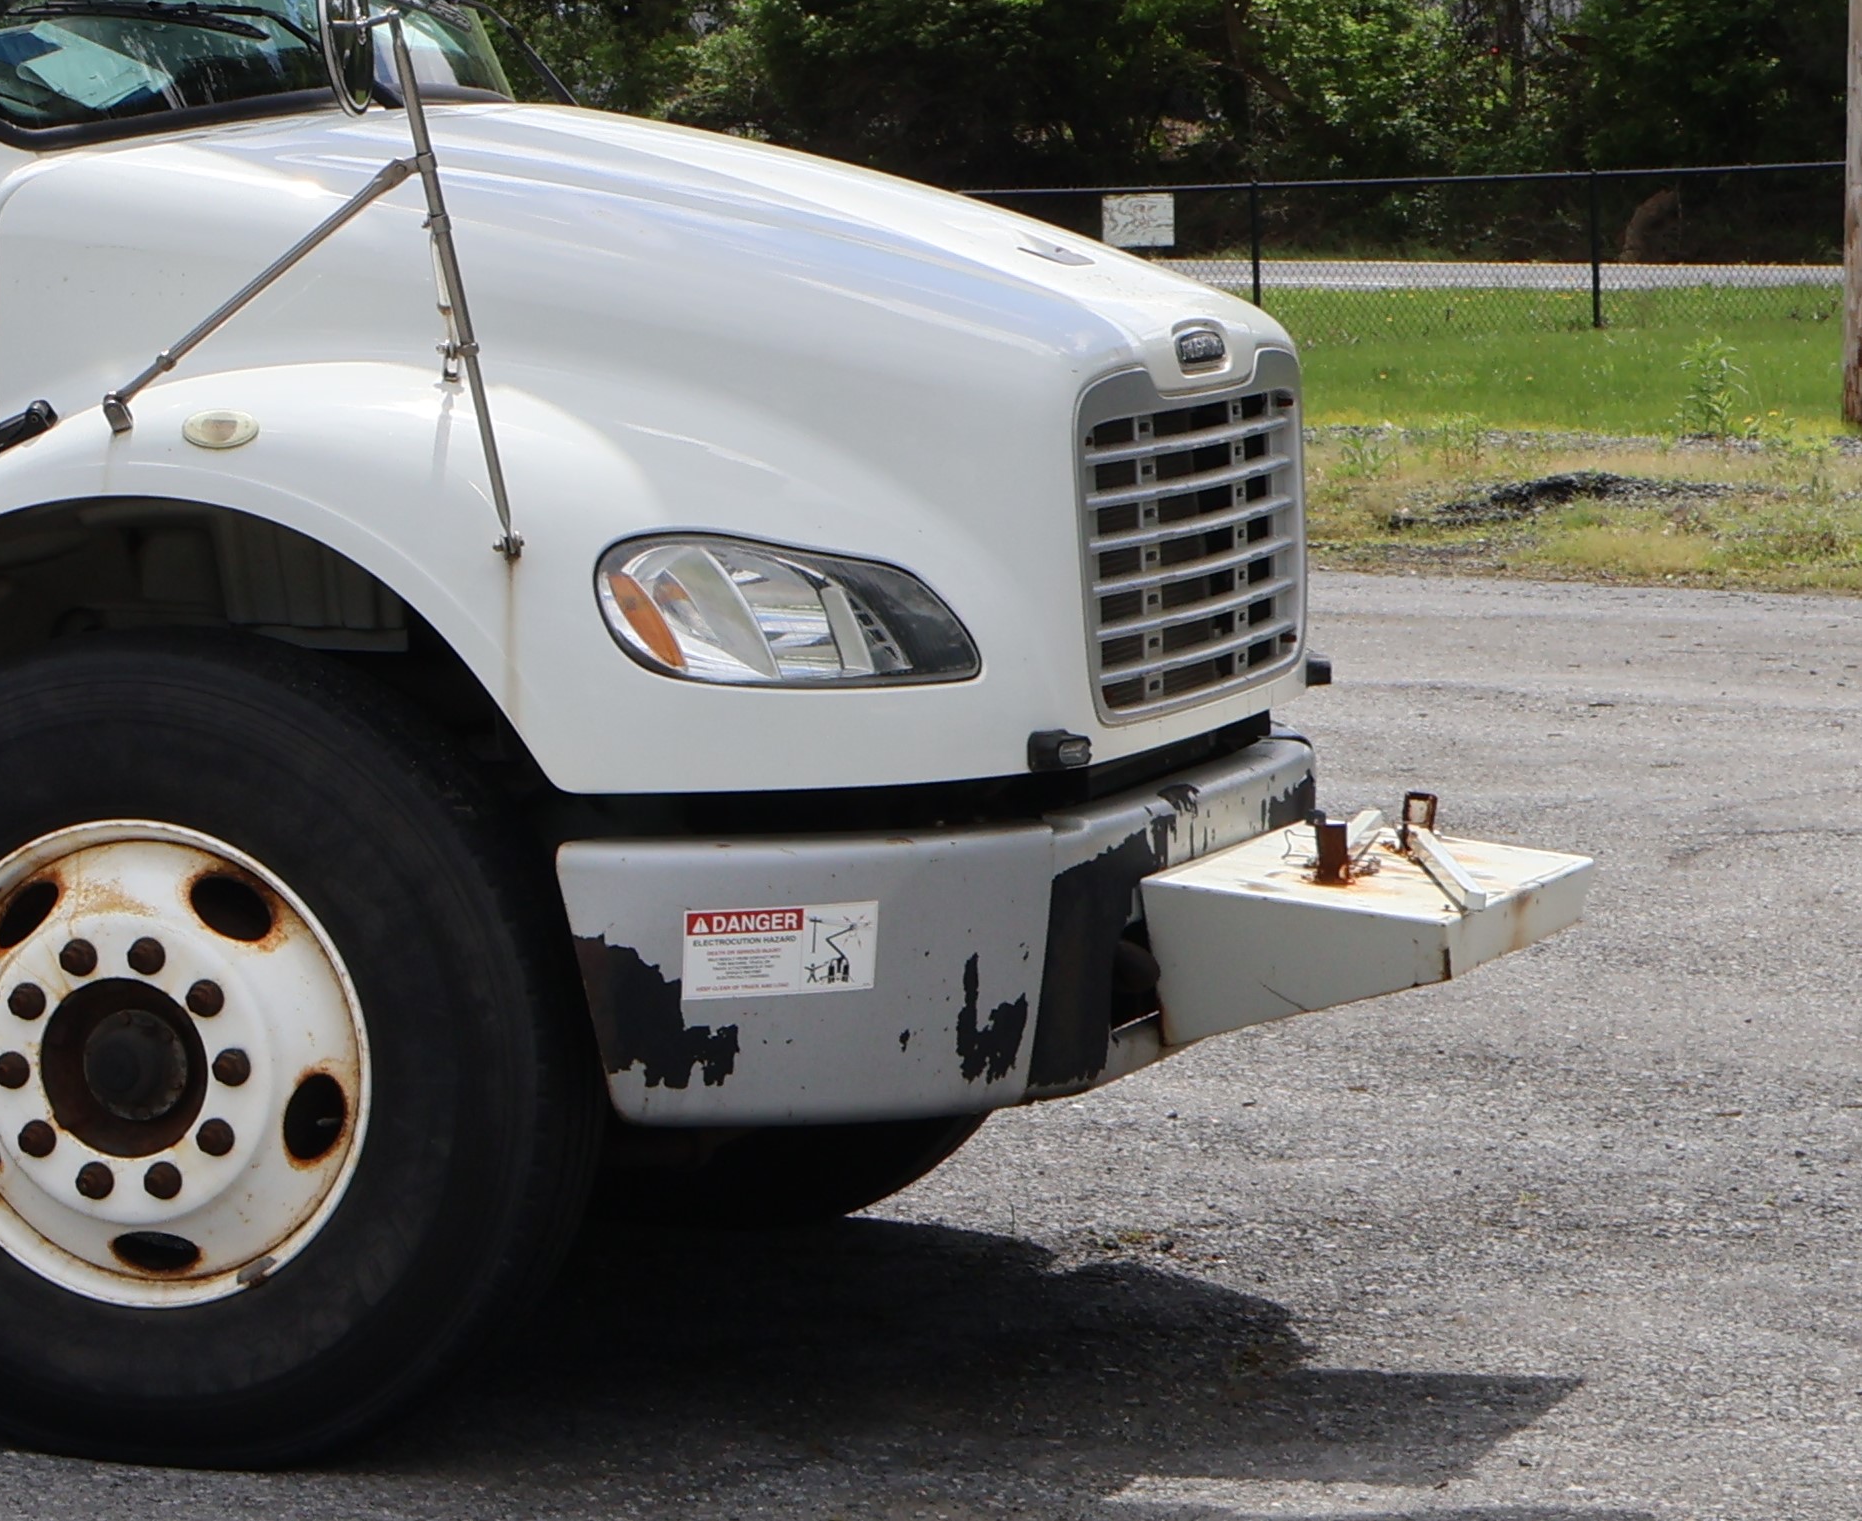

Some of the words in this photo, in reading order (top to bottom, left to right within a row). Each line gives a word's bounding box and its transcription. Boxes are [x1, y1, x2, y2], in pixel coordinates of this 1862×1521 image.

[713, 912, 798, 932] DANGER
[693, 937, 761, 947] ELECTROCUTION
[763, 935, 796, 944] HAZARD
